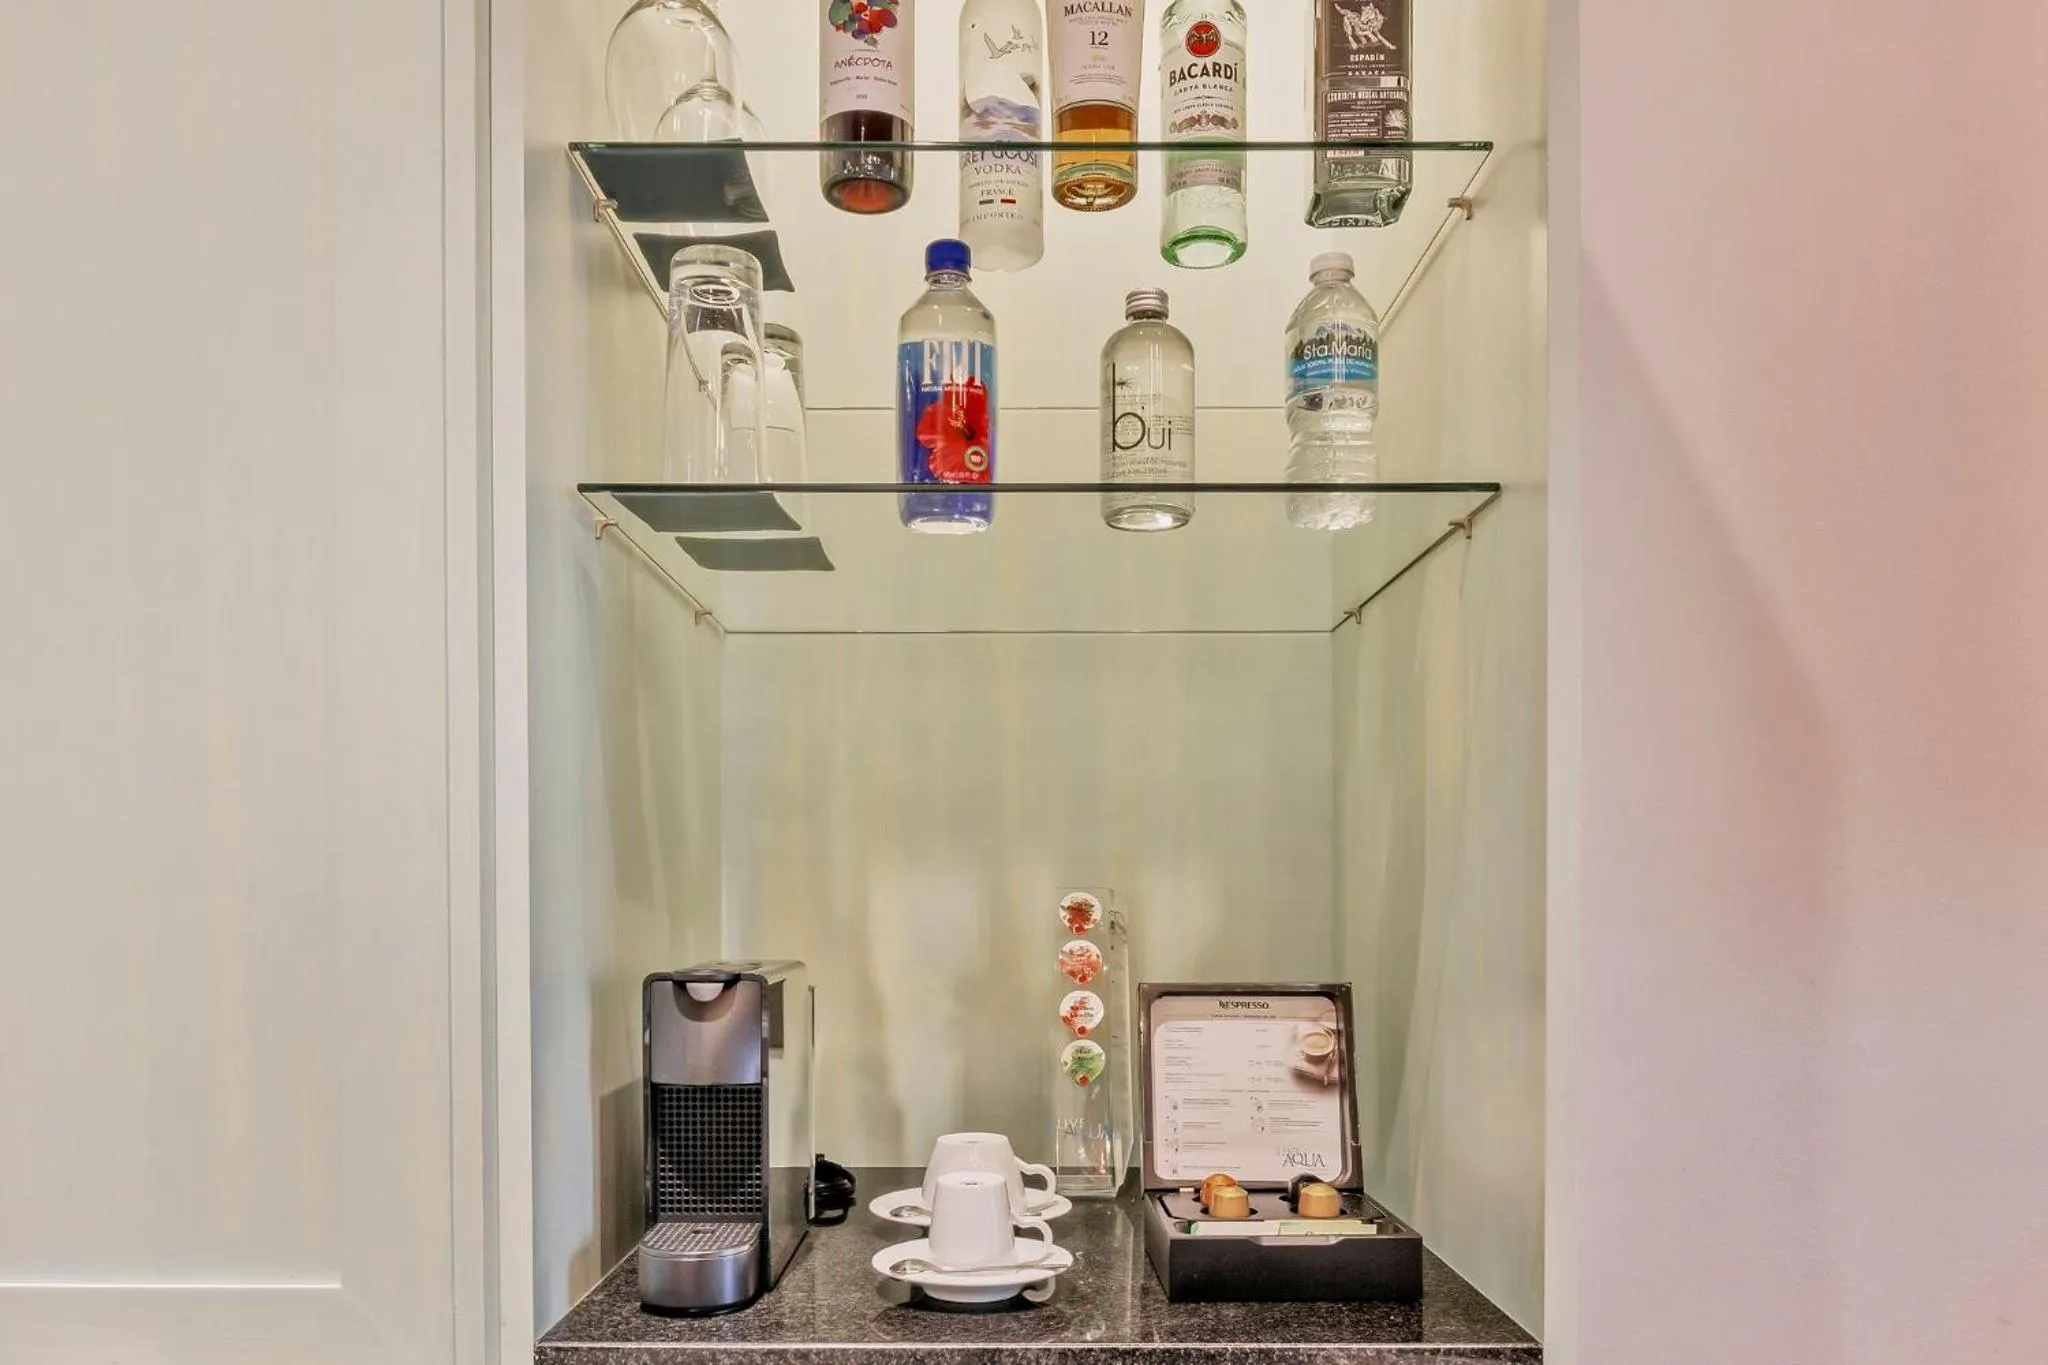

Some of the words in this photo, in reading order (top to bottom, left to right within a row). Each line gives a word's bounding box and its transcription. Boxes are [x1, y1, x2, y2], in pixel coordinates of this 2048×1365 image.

[1064, 1, 1132, 17] MACALLAN
[1088, 31, 1109, 46] 12
[1169, 62, 1239, 87] BACARDÍ
[1202, 84, 1234, 93] BLANCA
[974, 164, 1022, 175] VODKA
[1218, 1000, 1270, 1009] NESPRESSO
[1282, 1152, 1327, 1168] AQUA
